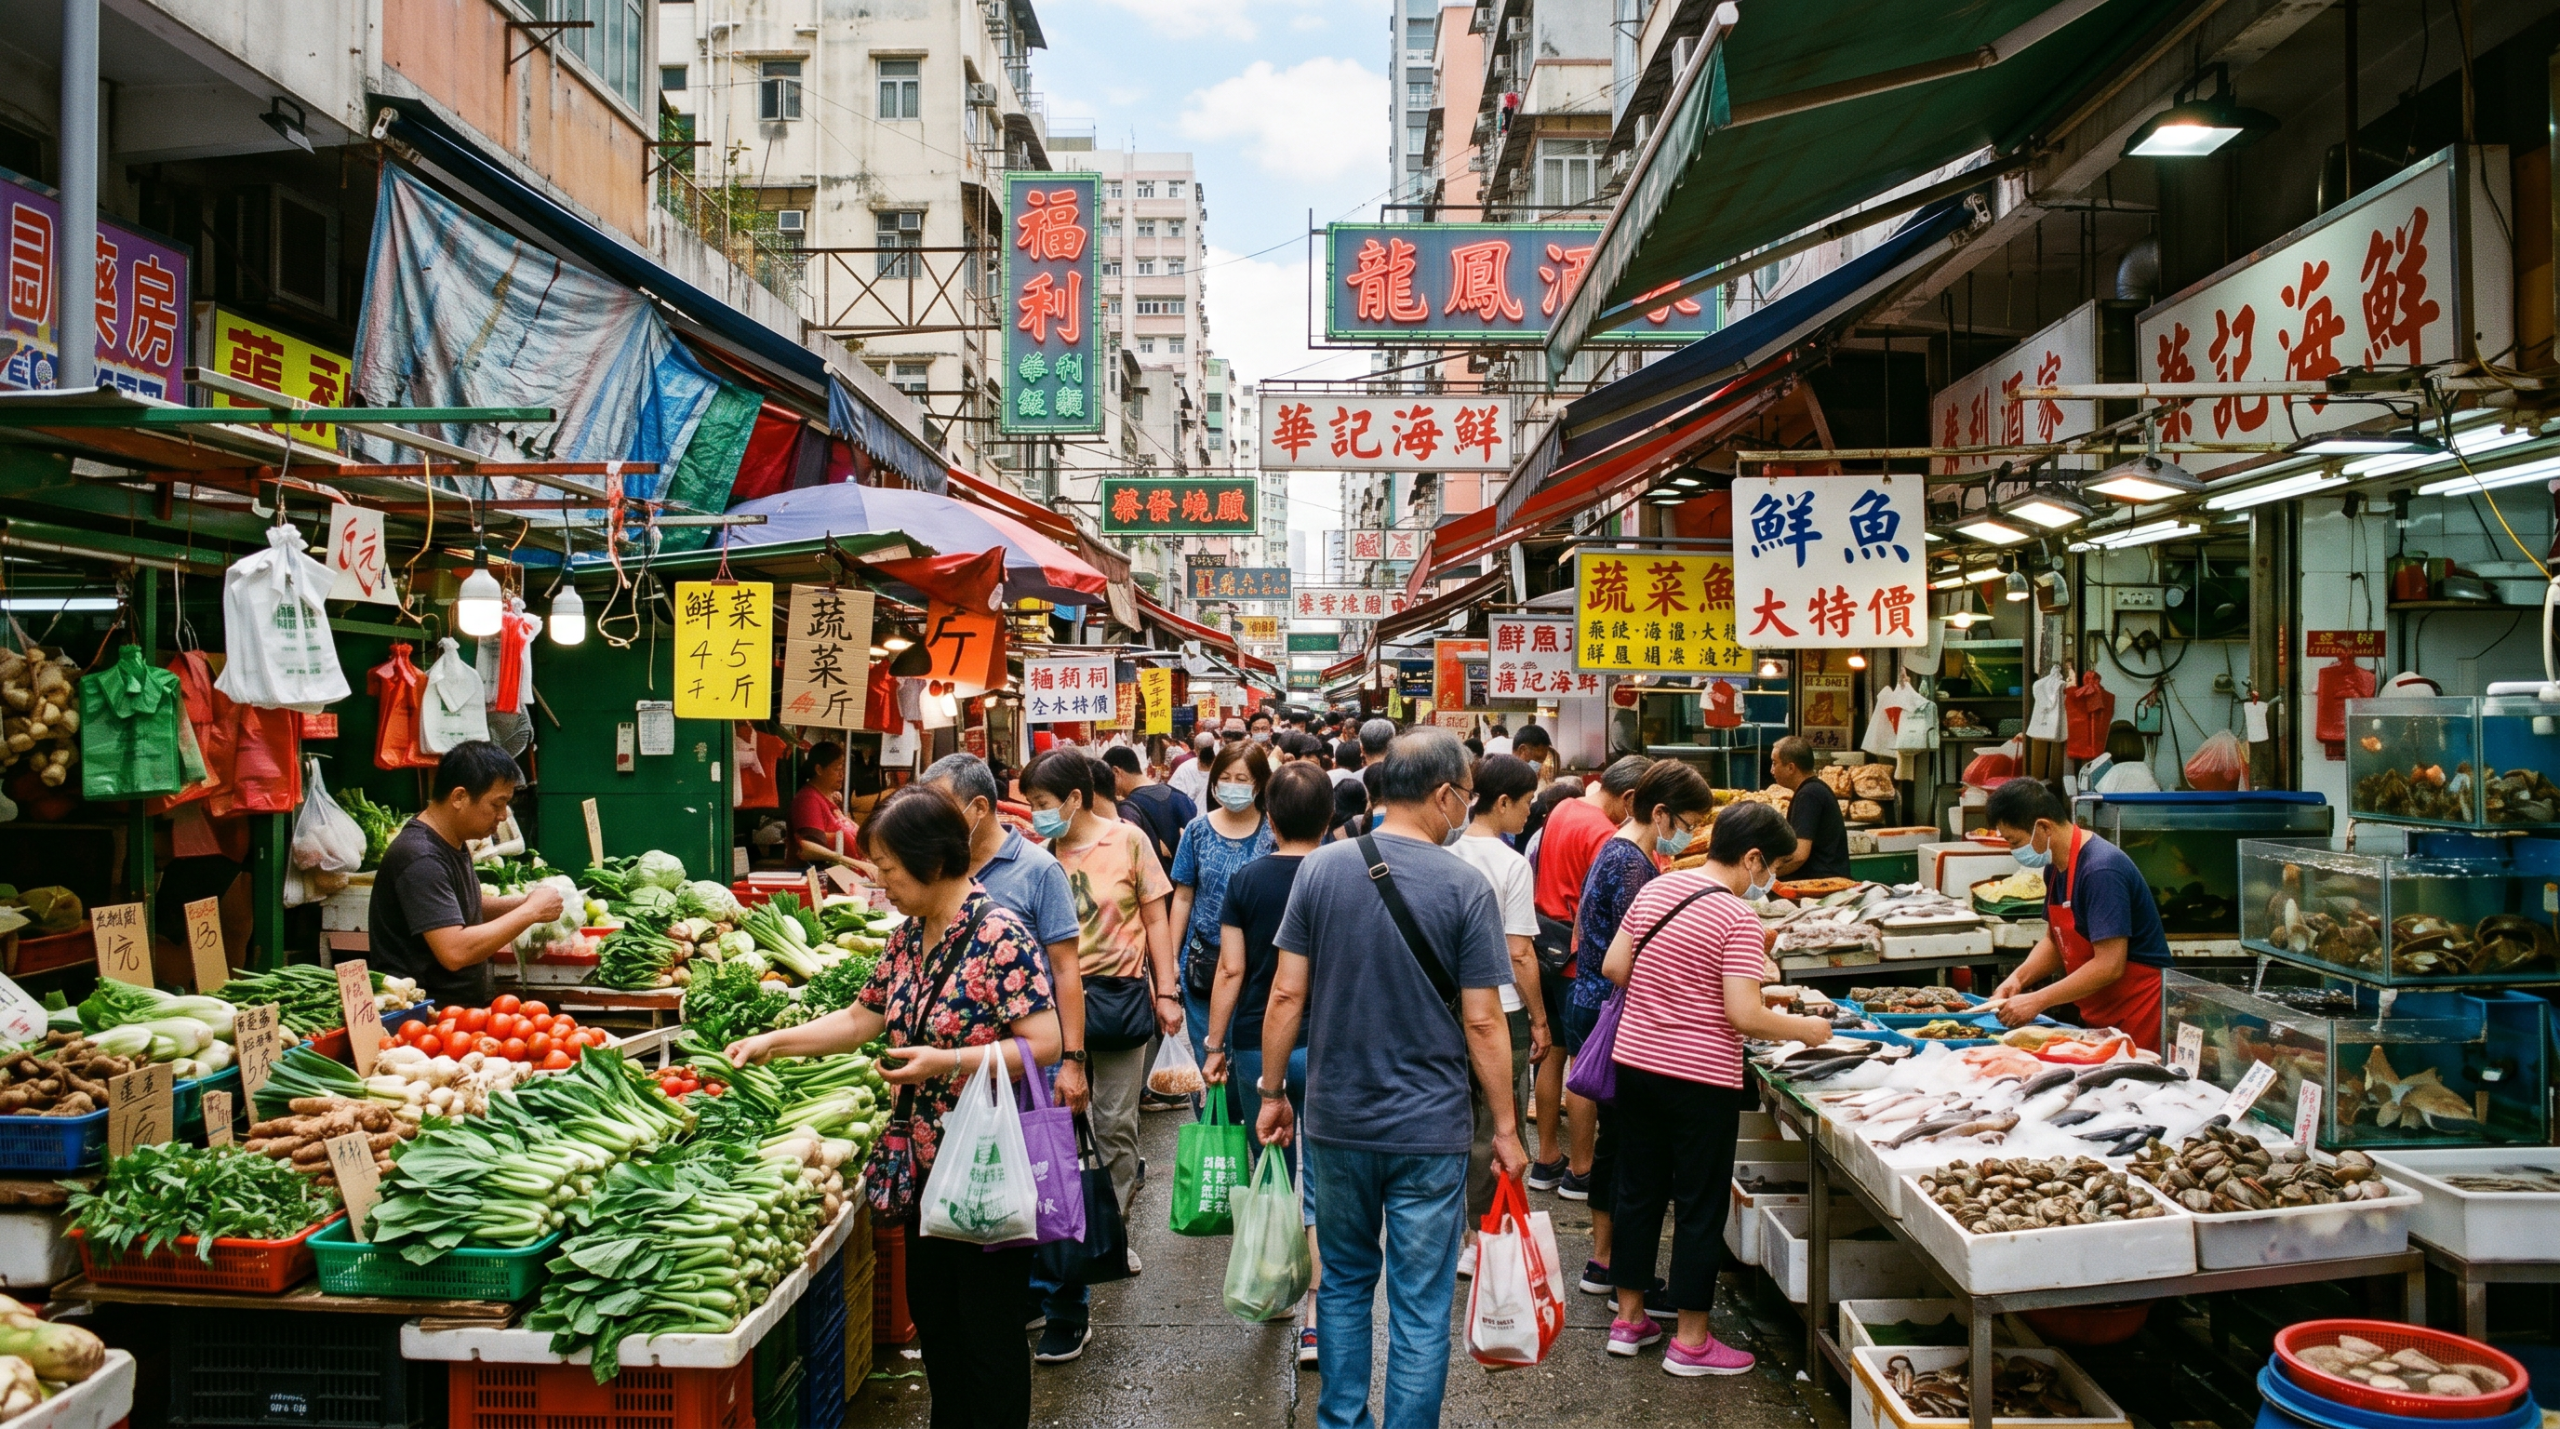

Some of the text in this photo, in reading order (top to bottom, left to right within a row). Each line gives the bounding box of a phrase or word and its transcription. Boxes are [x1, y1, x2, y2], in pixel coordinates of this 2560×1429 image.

[1017, 188, 1088, 344] 福利
[1271, 403, 1502, 464] 華記海鮮
[1750, 489, 1911, 569] 鮮魚
[685, 589, 762, 630] 鮮菜
[1587, 560, 1734, 617] 蔬菜魚
[1749, 584, 1916, 639] 大特價
